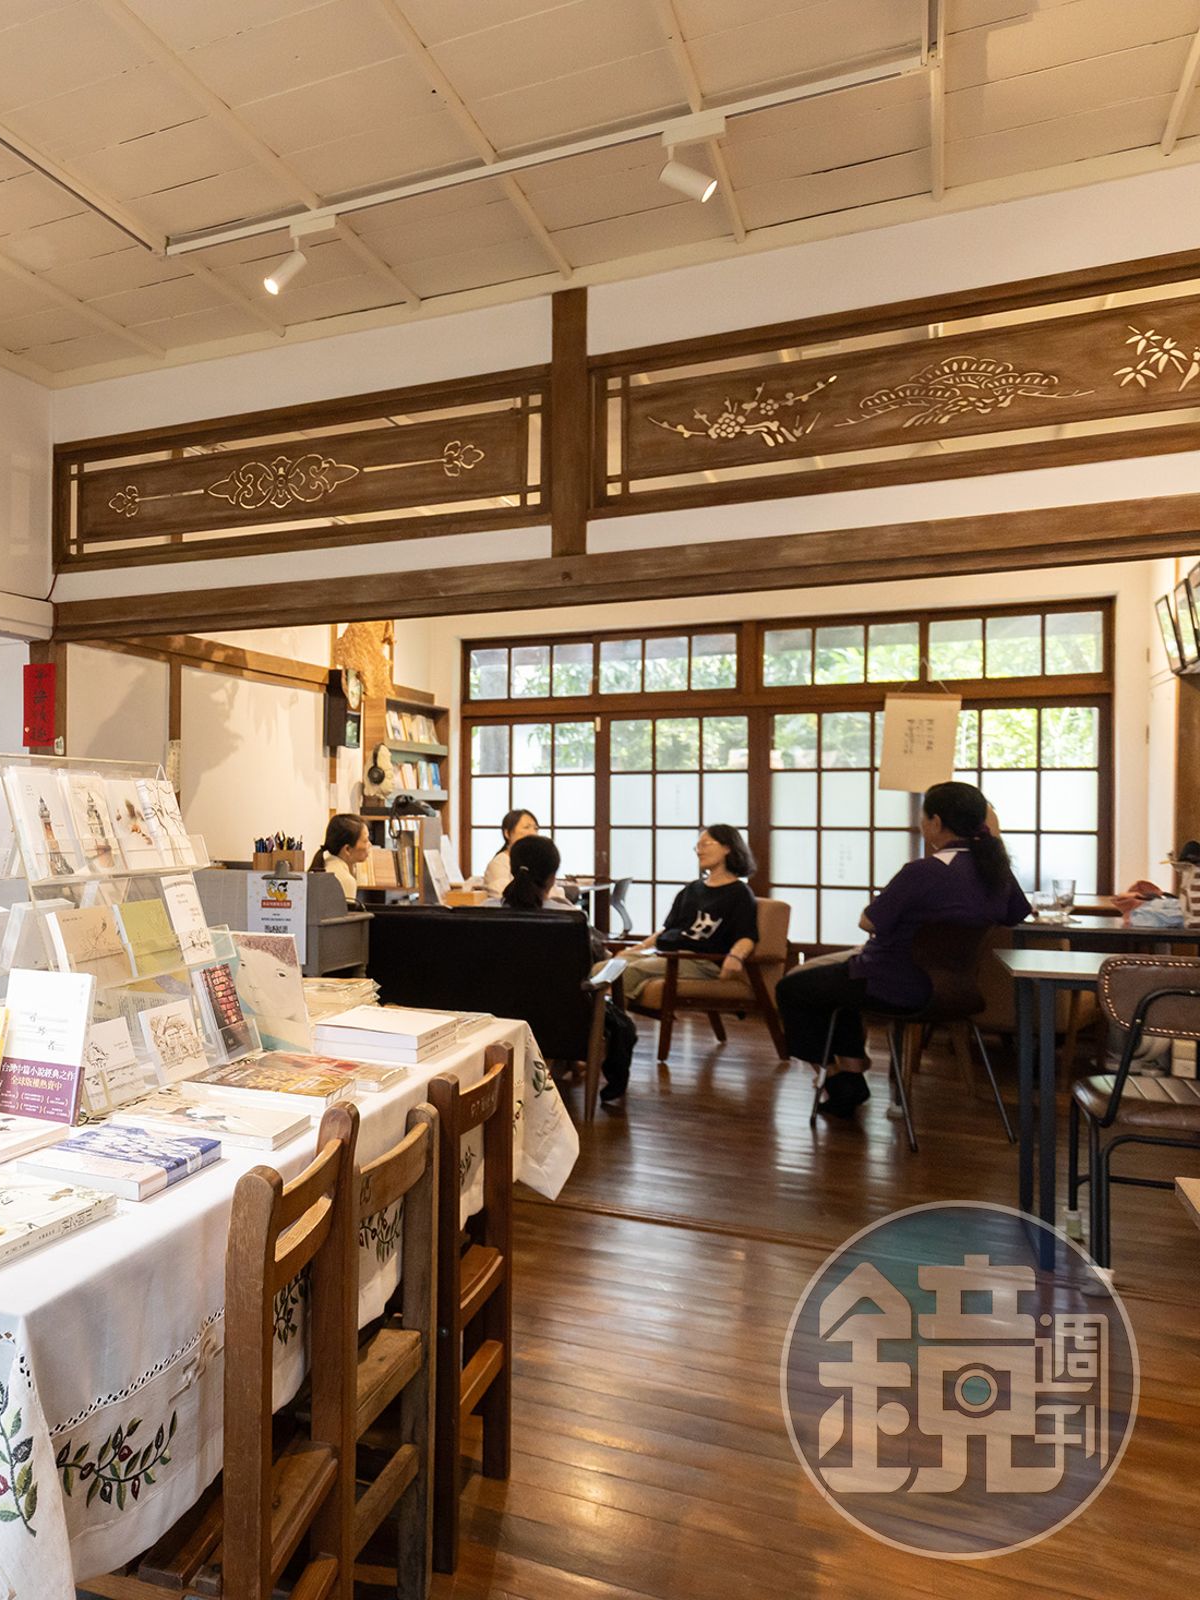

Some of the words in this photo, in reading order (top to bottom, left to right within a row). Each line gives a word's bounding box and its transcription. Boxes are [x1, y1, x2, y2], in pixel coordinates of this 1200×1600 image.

[1, 1062, 76, 1081] 台灣中篇小說經典之作
[11, 1075, 64, 1091] 全球版權熱賣中
